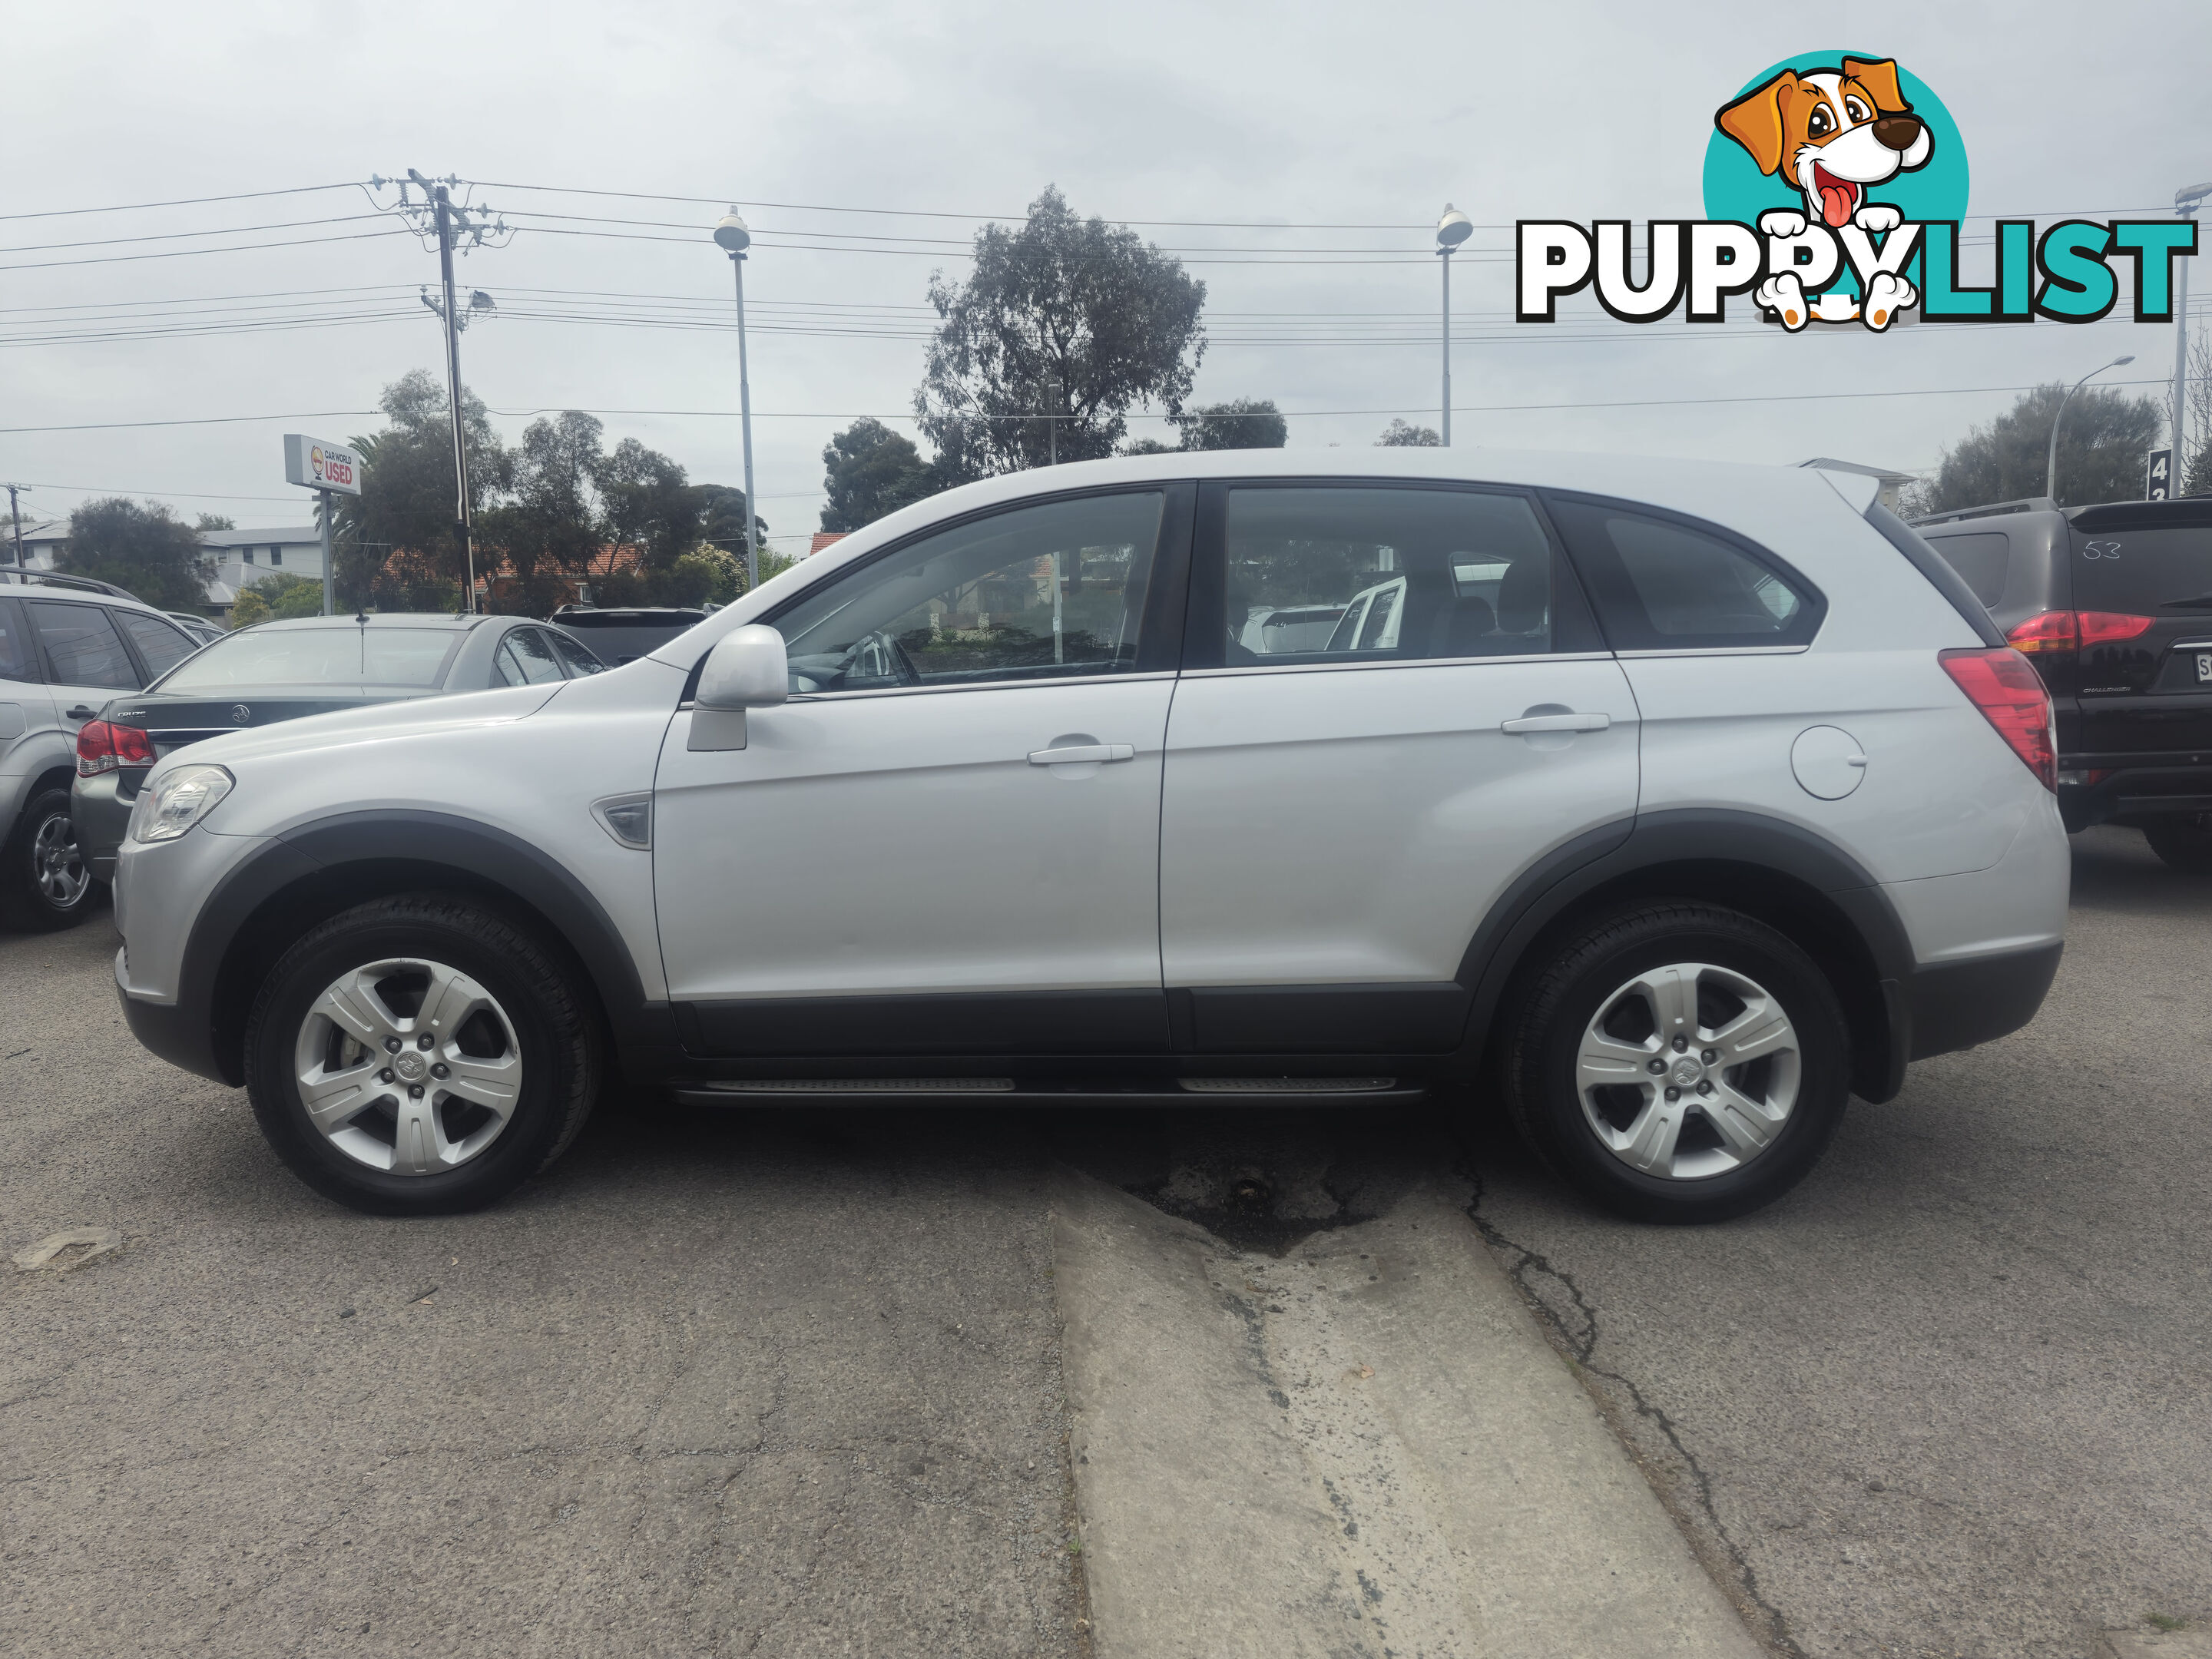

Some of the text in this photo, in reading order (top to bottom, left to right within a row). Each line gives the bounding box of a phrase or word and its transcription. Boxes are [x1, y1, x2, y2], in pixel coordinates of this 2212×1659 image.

[325, 450, 351, 465] CAR WORLD
[325, 461, 352, 485] USED
[2083, 541, 2121, 560] 53
[2199, 658, 2212, 676] S
